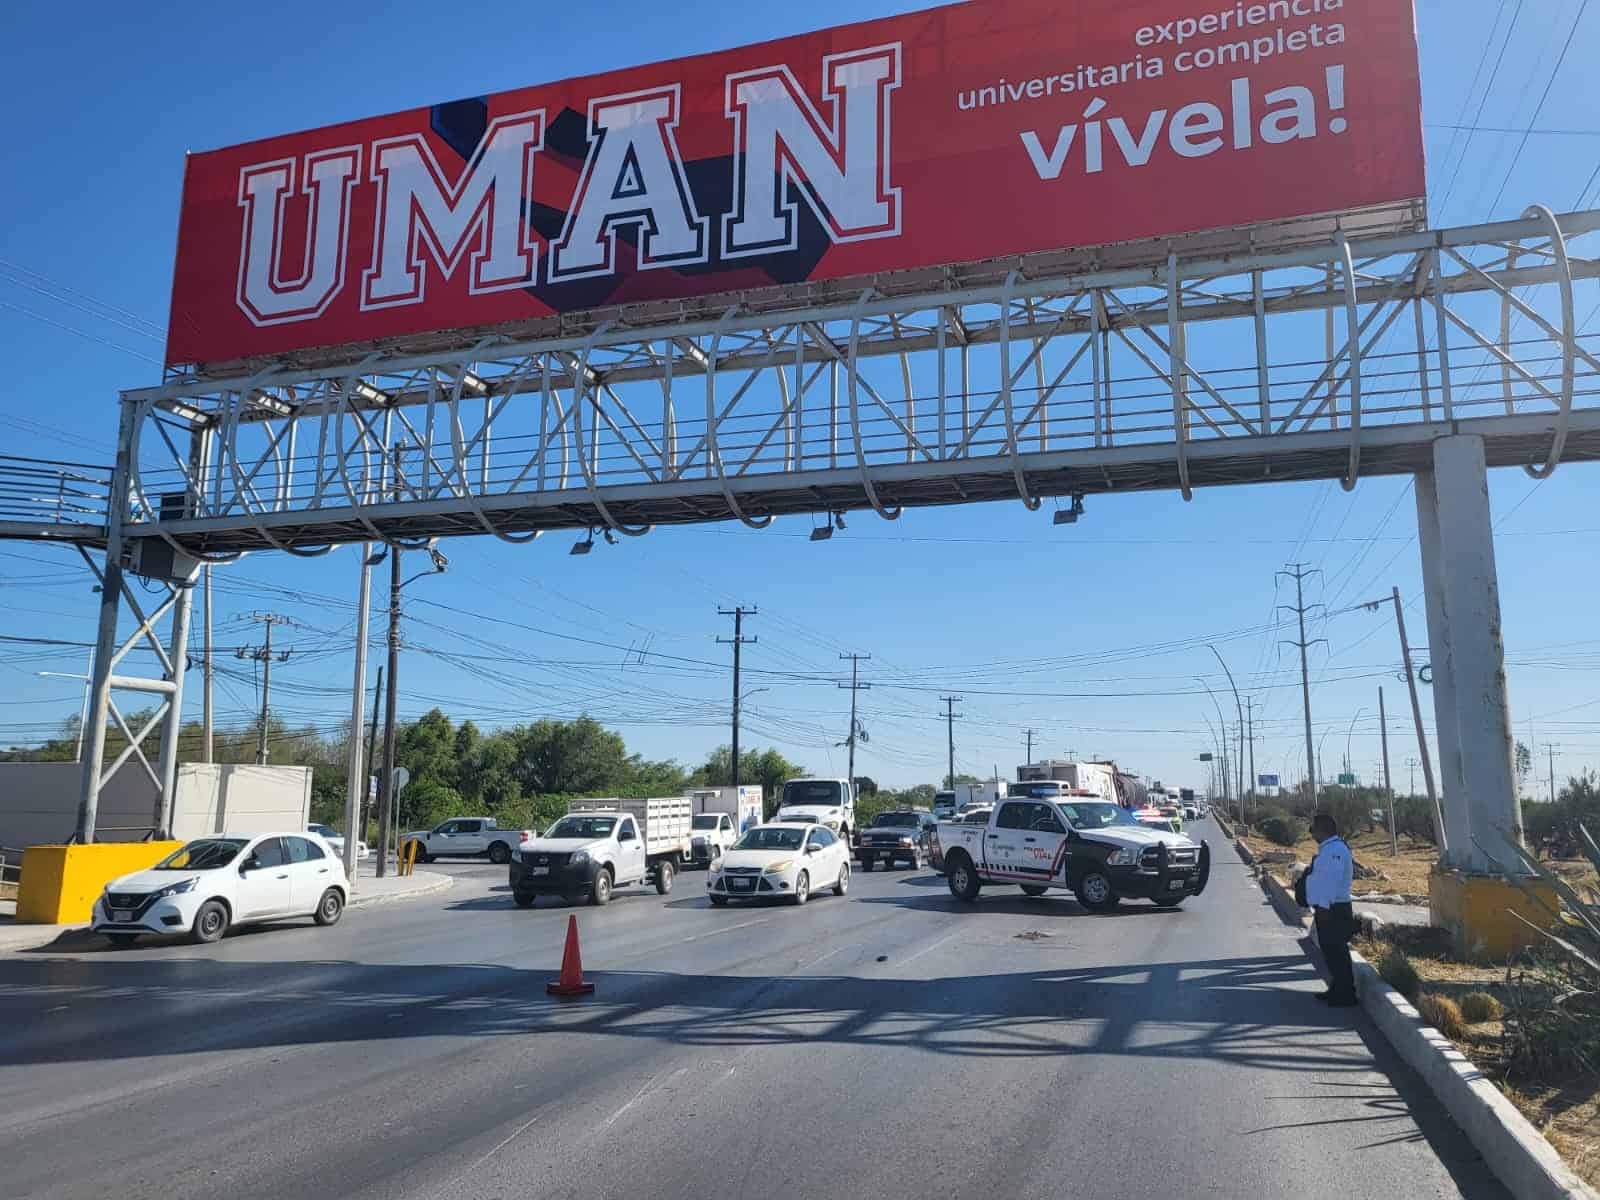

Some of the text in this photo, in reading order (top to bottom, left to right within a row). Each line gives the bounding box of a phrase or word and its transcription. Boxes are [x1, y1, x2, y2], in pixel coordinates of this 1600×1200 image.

[957, 23, 1345, 110] universitaria completa
[1135, 0, 1344, 46] experiencia
[1019, 64, 1349, 180] vívela!
[236, 42, 903, 328] UMAN
